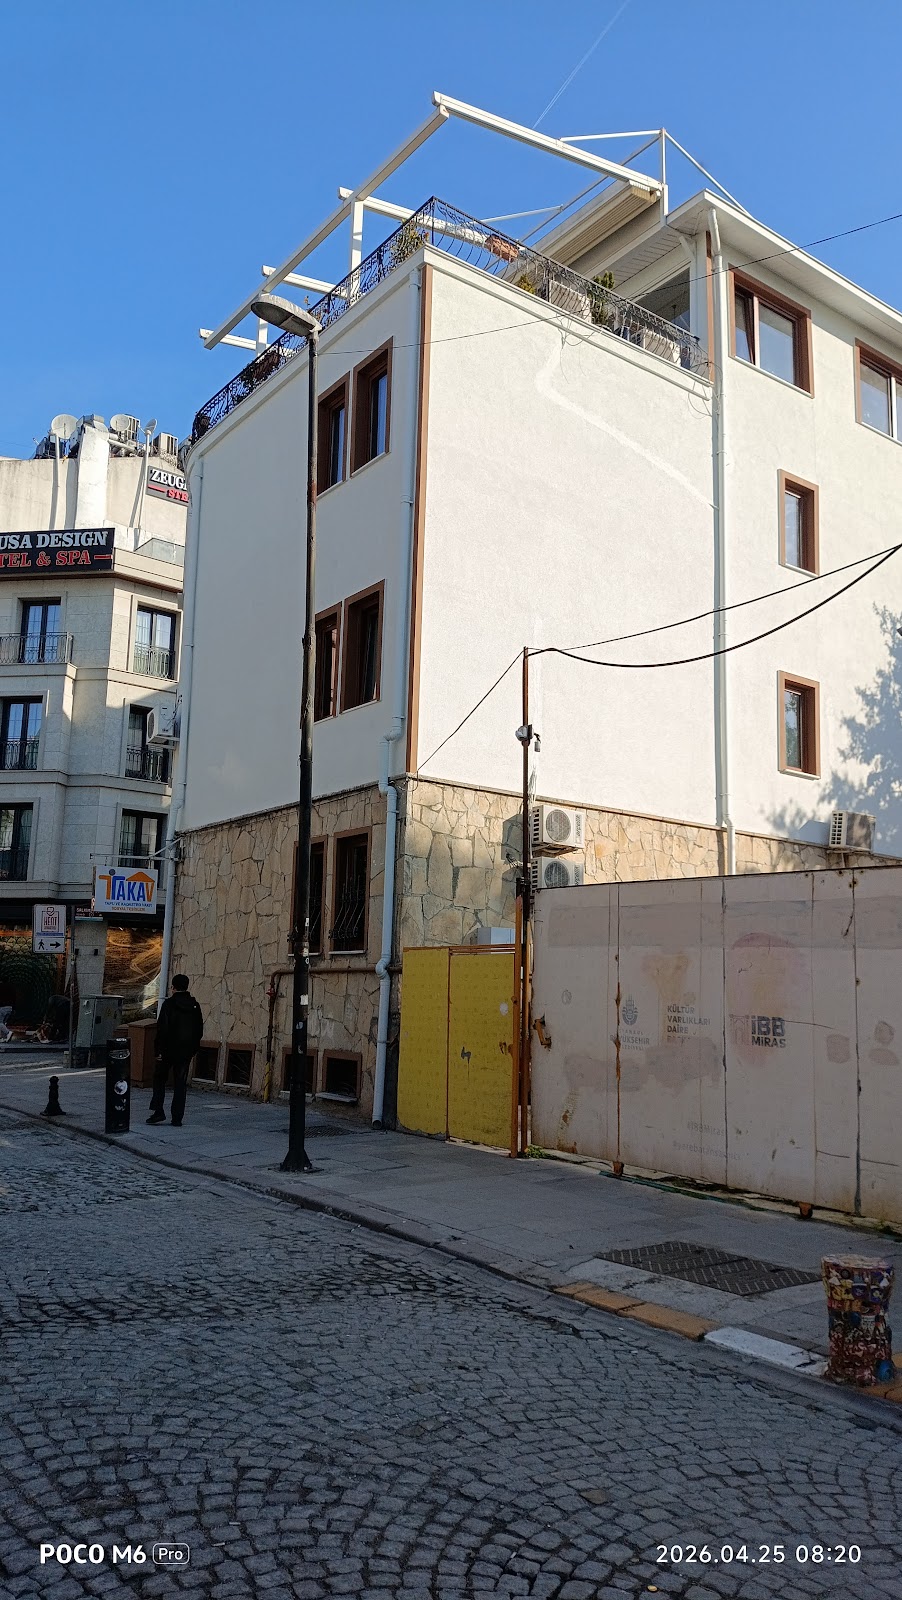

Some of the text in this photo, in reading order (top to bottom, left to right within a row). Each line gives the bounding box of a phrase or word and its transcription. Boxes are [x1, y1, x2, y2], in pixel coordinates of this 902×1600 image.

[36, 531, 108, 548] DESIGN
[36, 551, 51, 567] &
[55, 550, 91, 565] SPA
[667, 1003, 695, 1014] KÜLTÜR
[667, 1015, 711, 1026] VARLIKLARI
[667, 1024, 689, 1034] DAİRE
